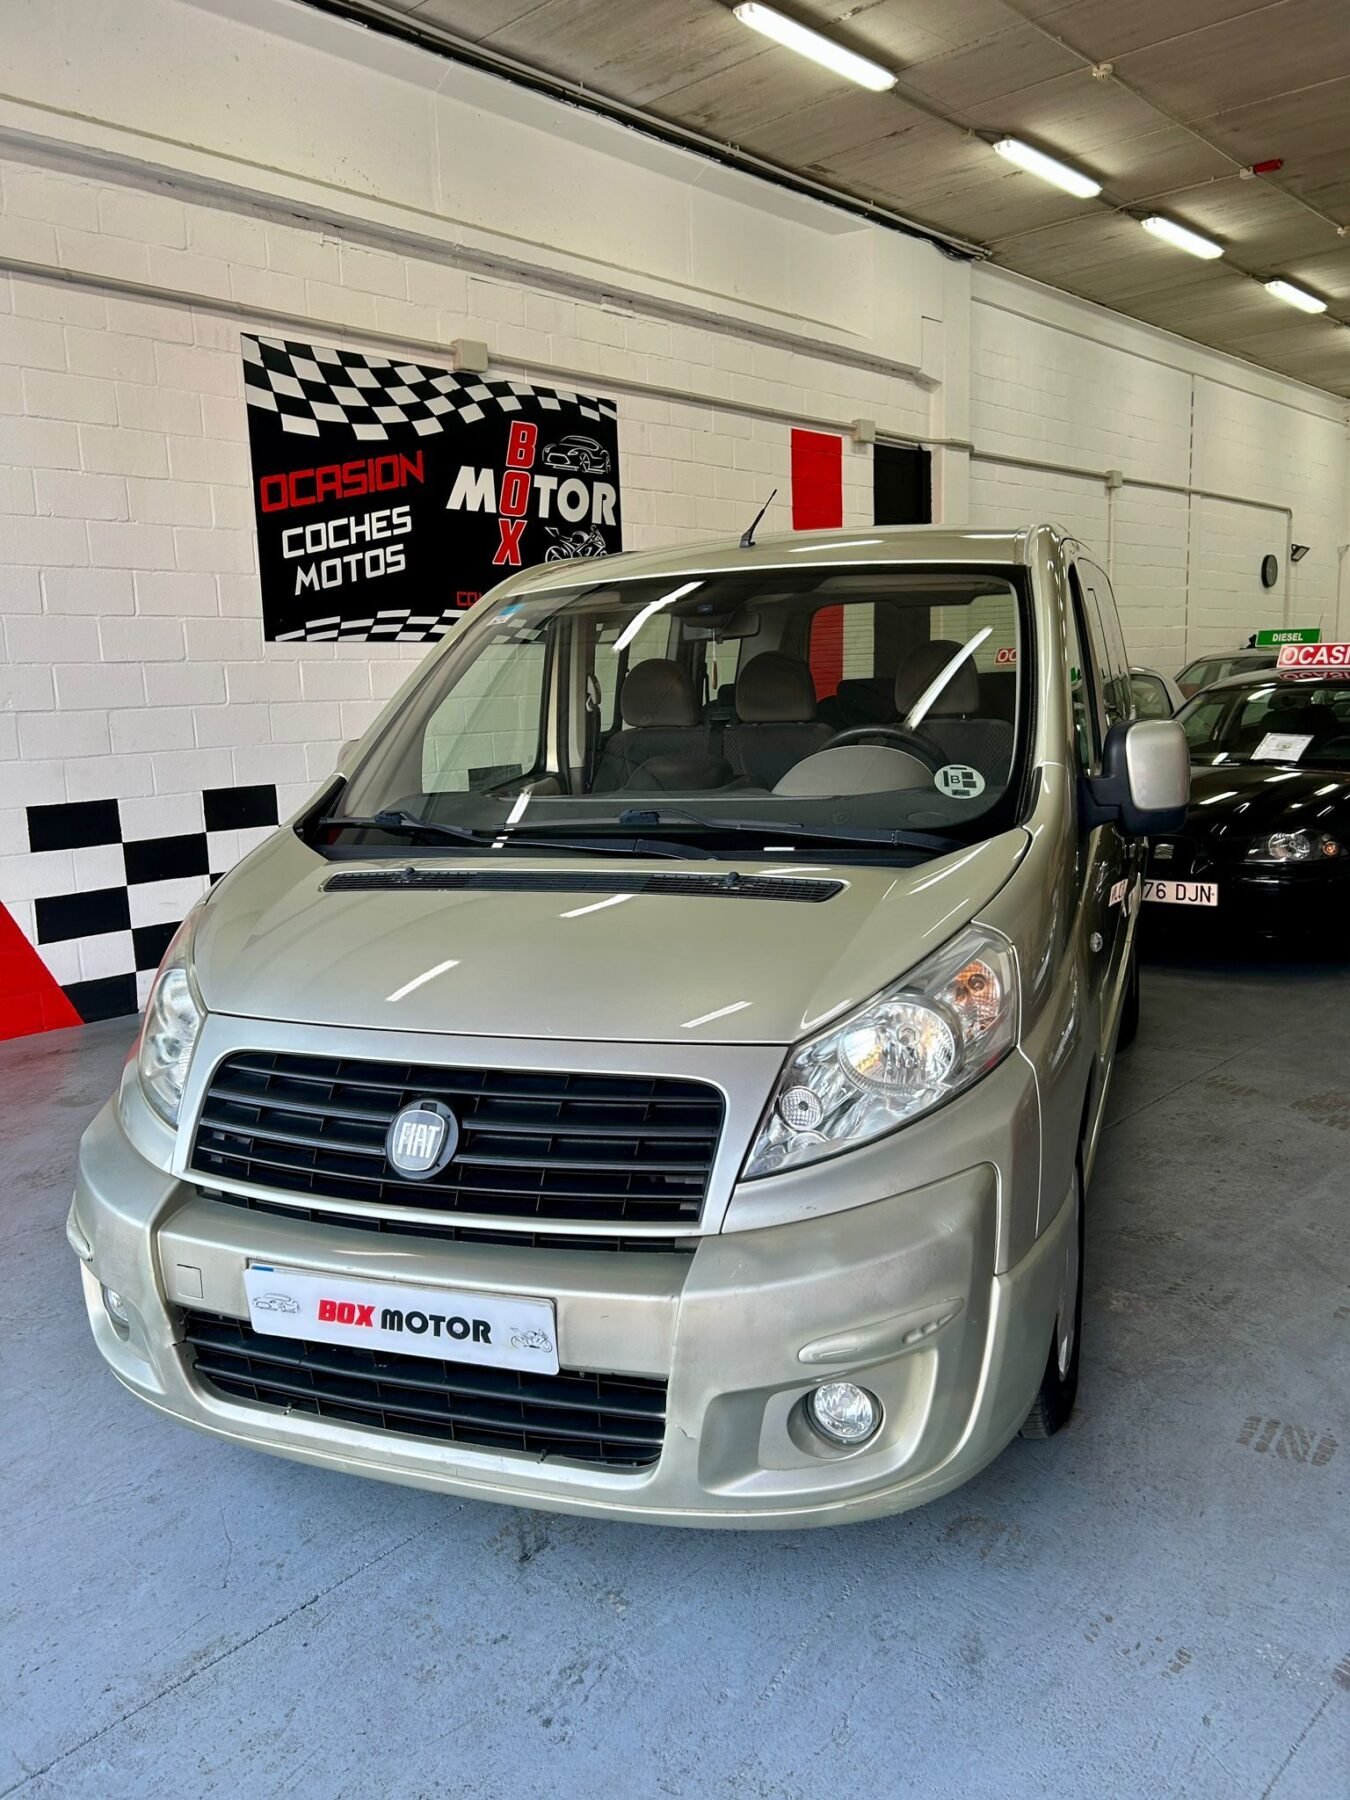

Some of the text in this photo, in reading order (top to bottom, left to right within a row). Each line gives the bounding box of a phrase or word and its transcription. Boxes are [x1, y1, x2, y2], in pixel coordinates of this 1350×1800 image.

[260, 450, 425, 513] OCASION
[493, 420, 538, 566] BOX
[282, 505, 412, 559] COCHES
[295, 543, 406, 596] MOTOS
[1272, 632, 1303, 642] DIESEL
[1144, 881, 1167, 900] 76
[1175, 883, 1212, 903] DJN
[397, 1121, 440, 1159] FIAT
[318, 1299, 492, 1344] BOX MOTOR
